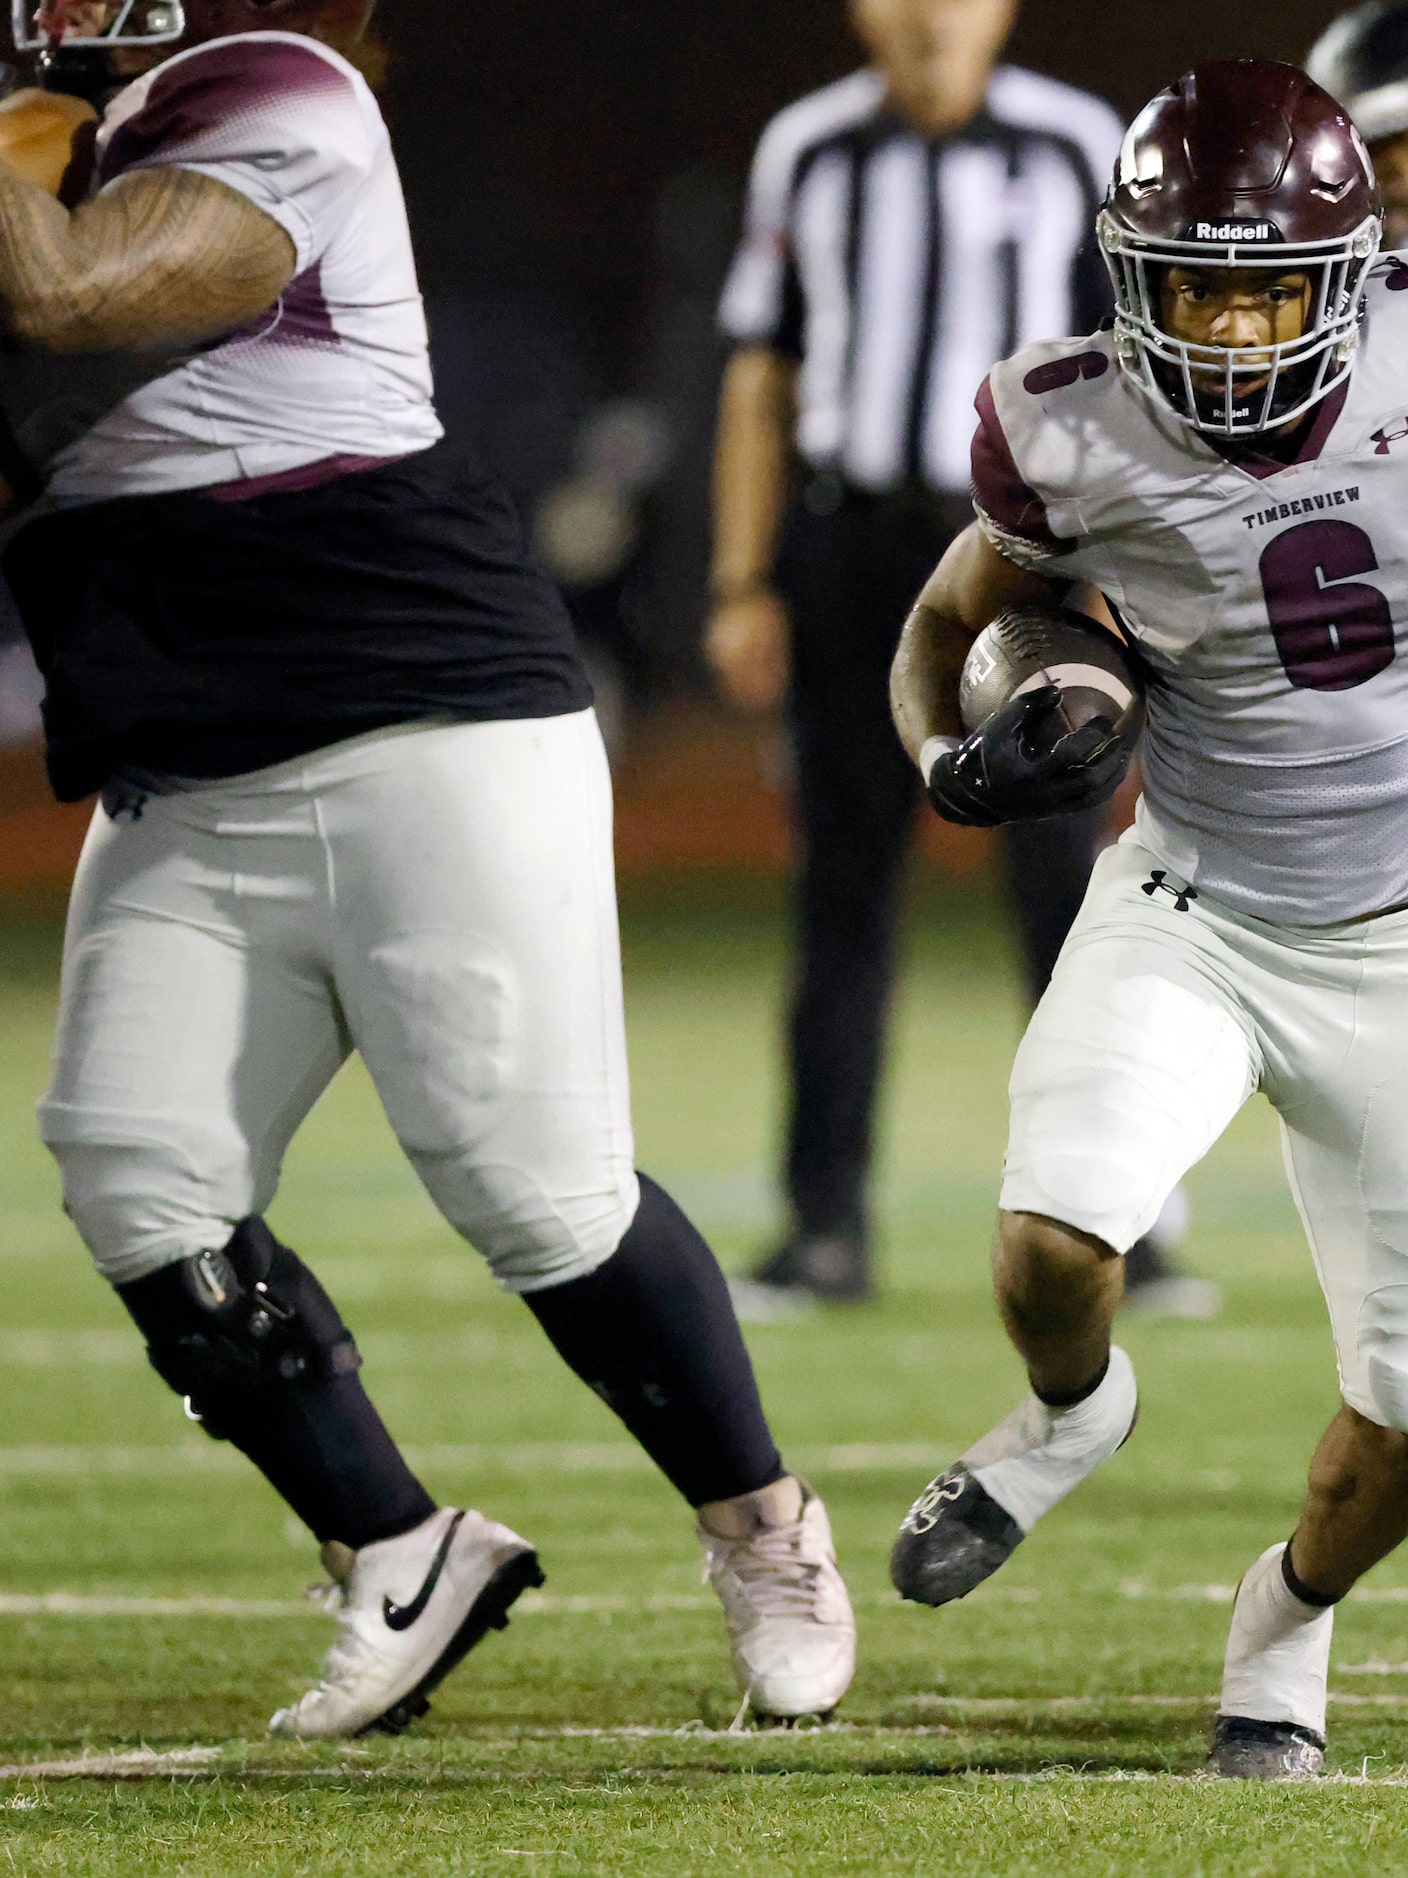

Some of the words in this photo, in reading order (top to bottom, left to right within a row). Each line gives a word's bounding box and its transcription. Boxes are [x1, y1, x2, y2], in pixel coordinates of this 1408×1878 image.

[1196, 222, 1269, 240] Riddell
[1023, 350, 1109, 395] 6
[1212, 407, 1249, 418] Ridell
[1242, 486, 1360, 529] TIMBERVIEW
[1259, 519, 1396, 692] 6
